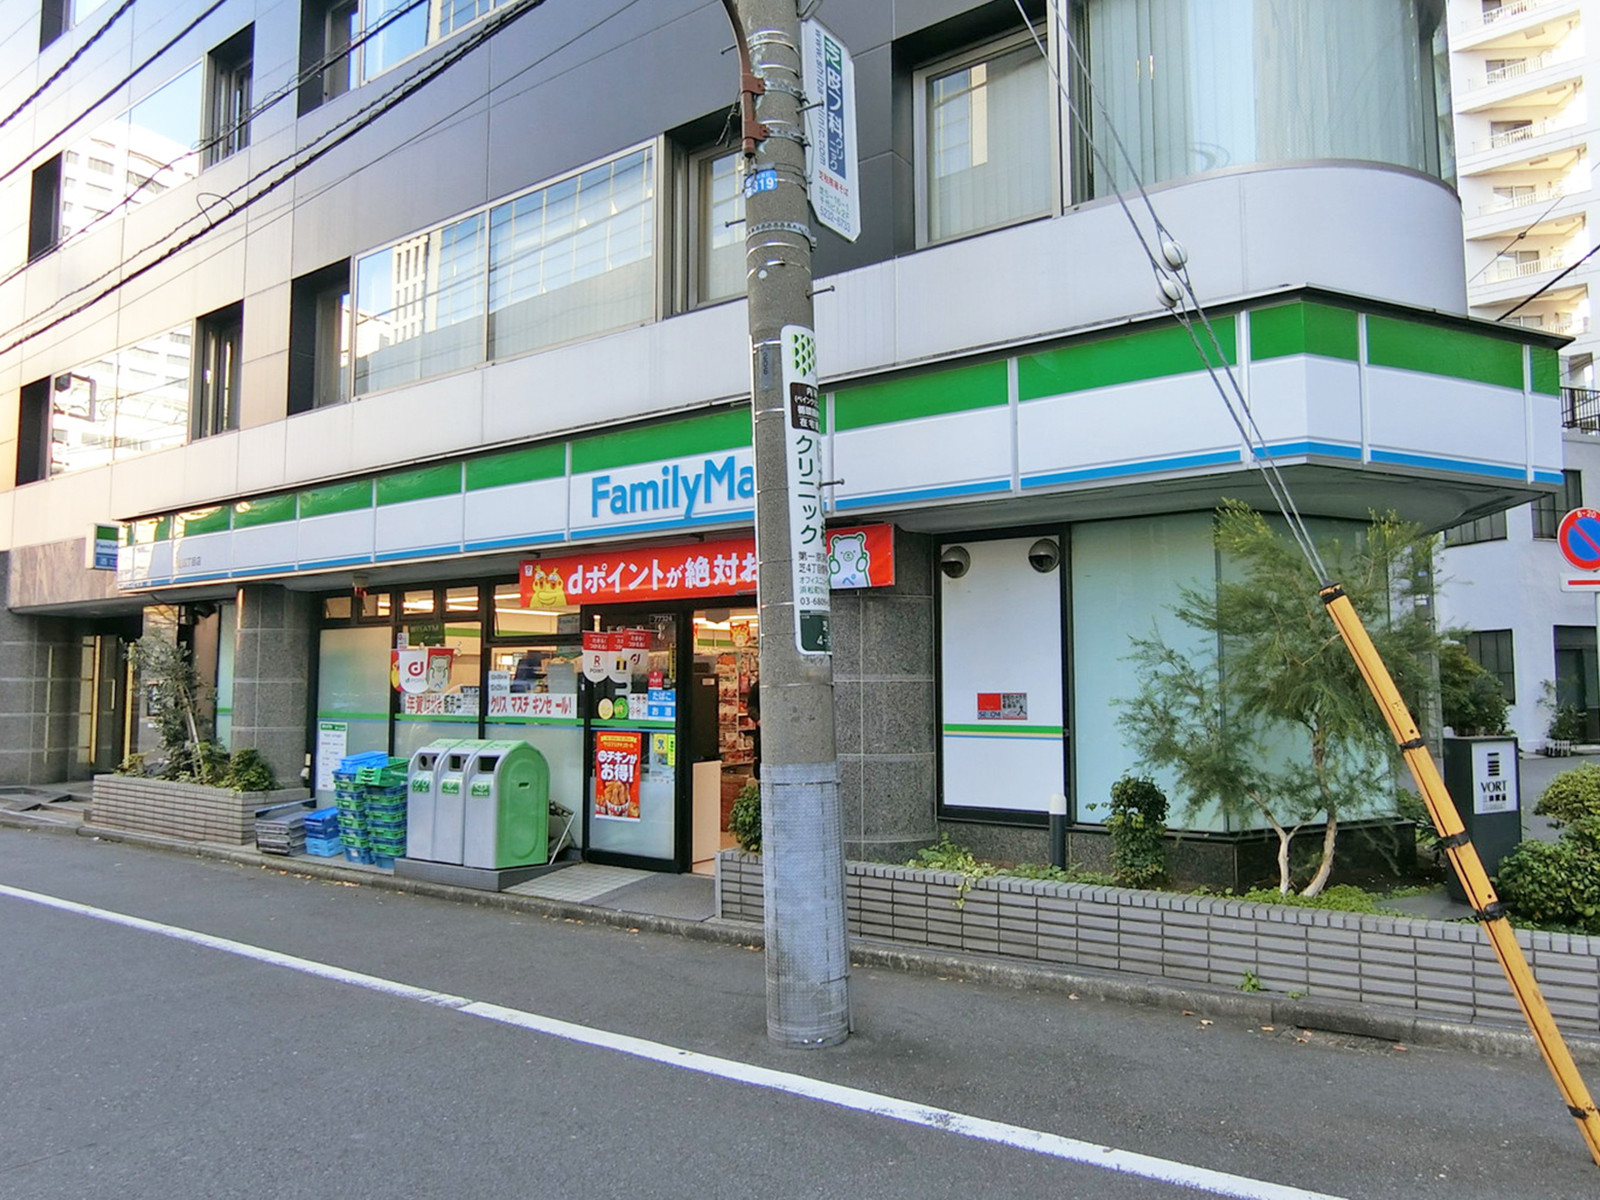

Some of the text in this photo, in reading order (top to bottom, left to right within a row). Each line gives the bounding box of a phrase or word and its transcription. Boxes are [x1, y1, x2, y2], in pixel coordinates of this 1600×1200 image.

[796, 435, 816, 544] クリニック
[652, 691, 672, 700] たばこ
[601, 763, 634, 783] お得!
[1480, 780, 1507, 793] VORT
